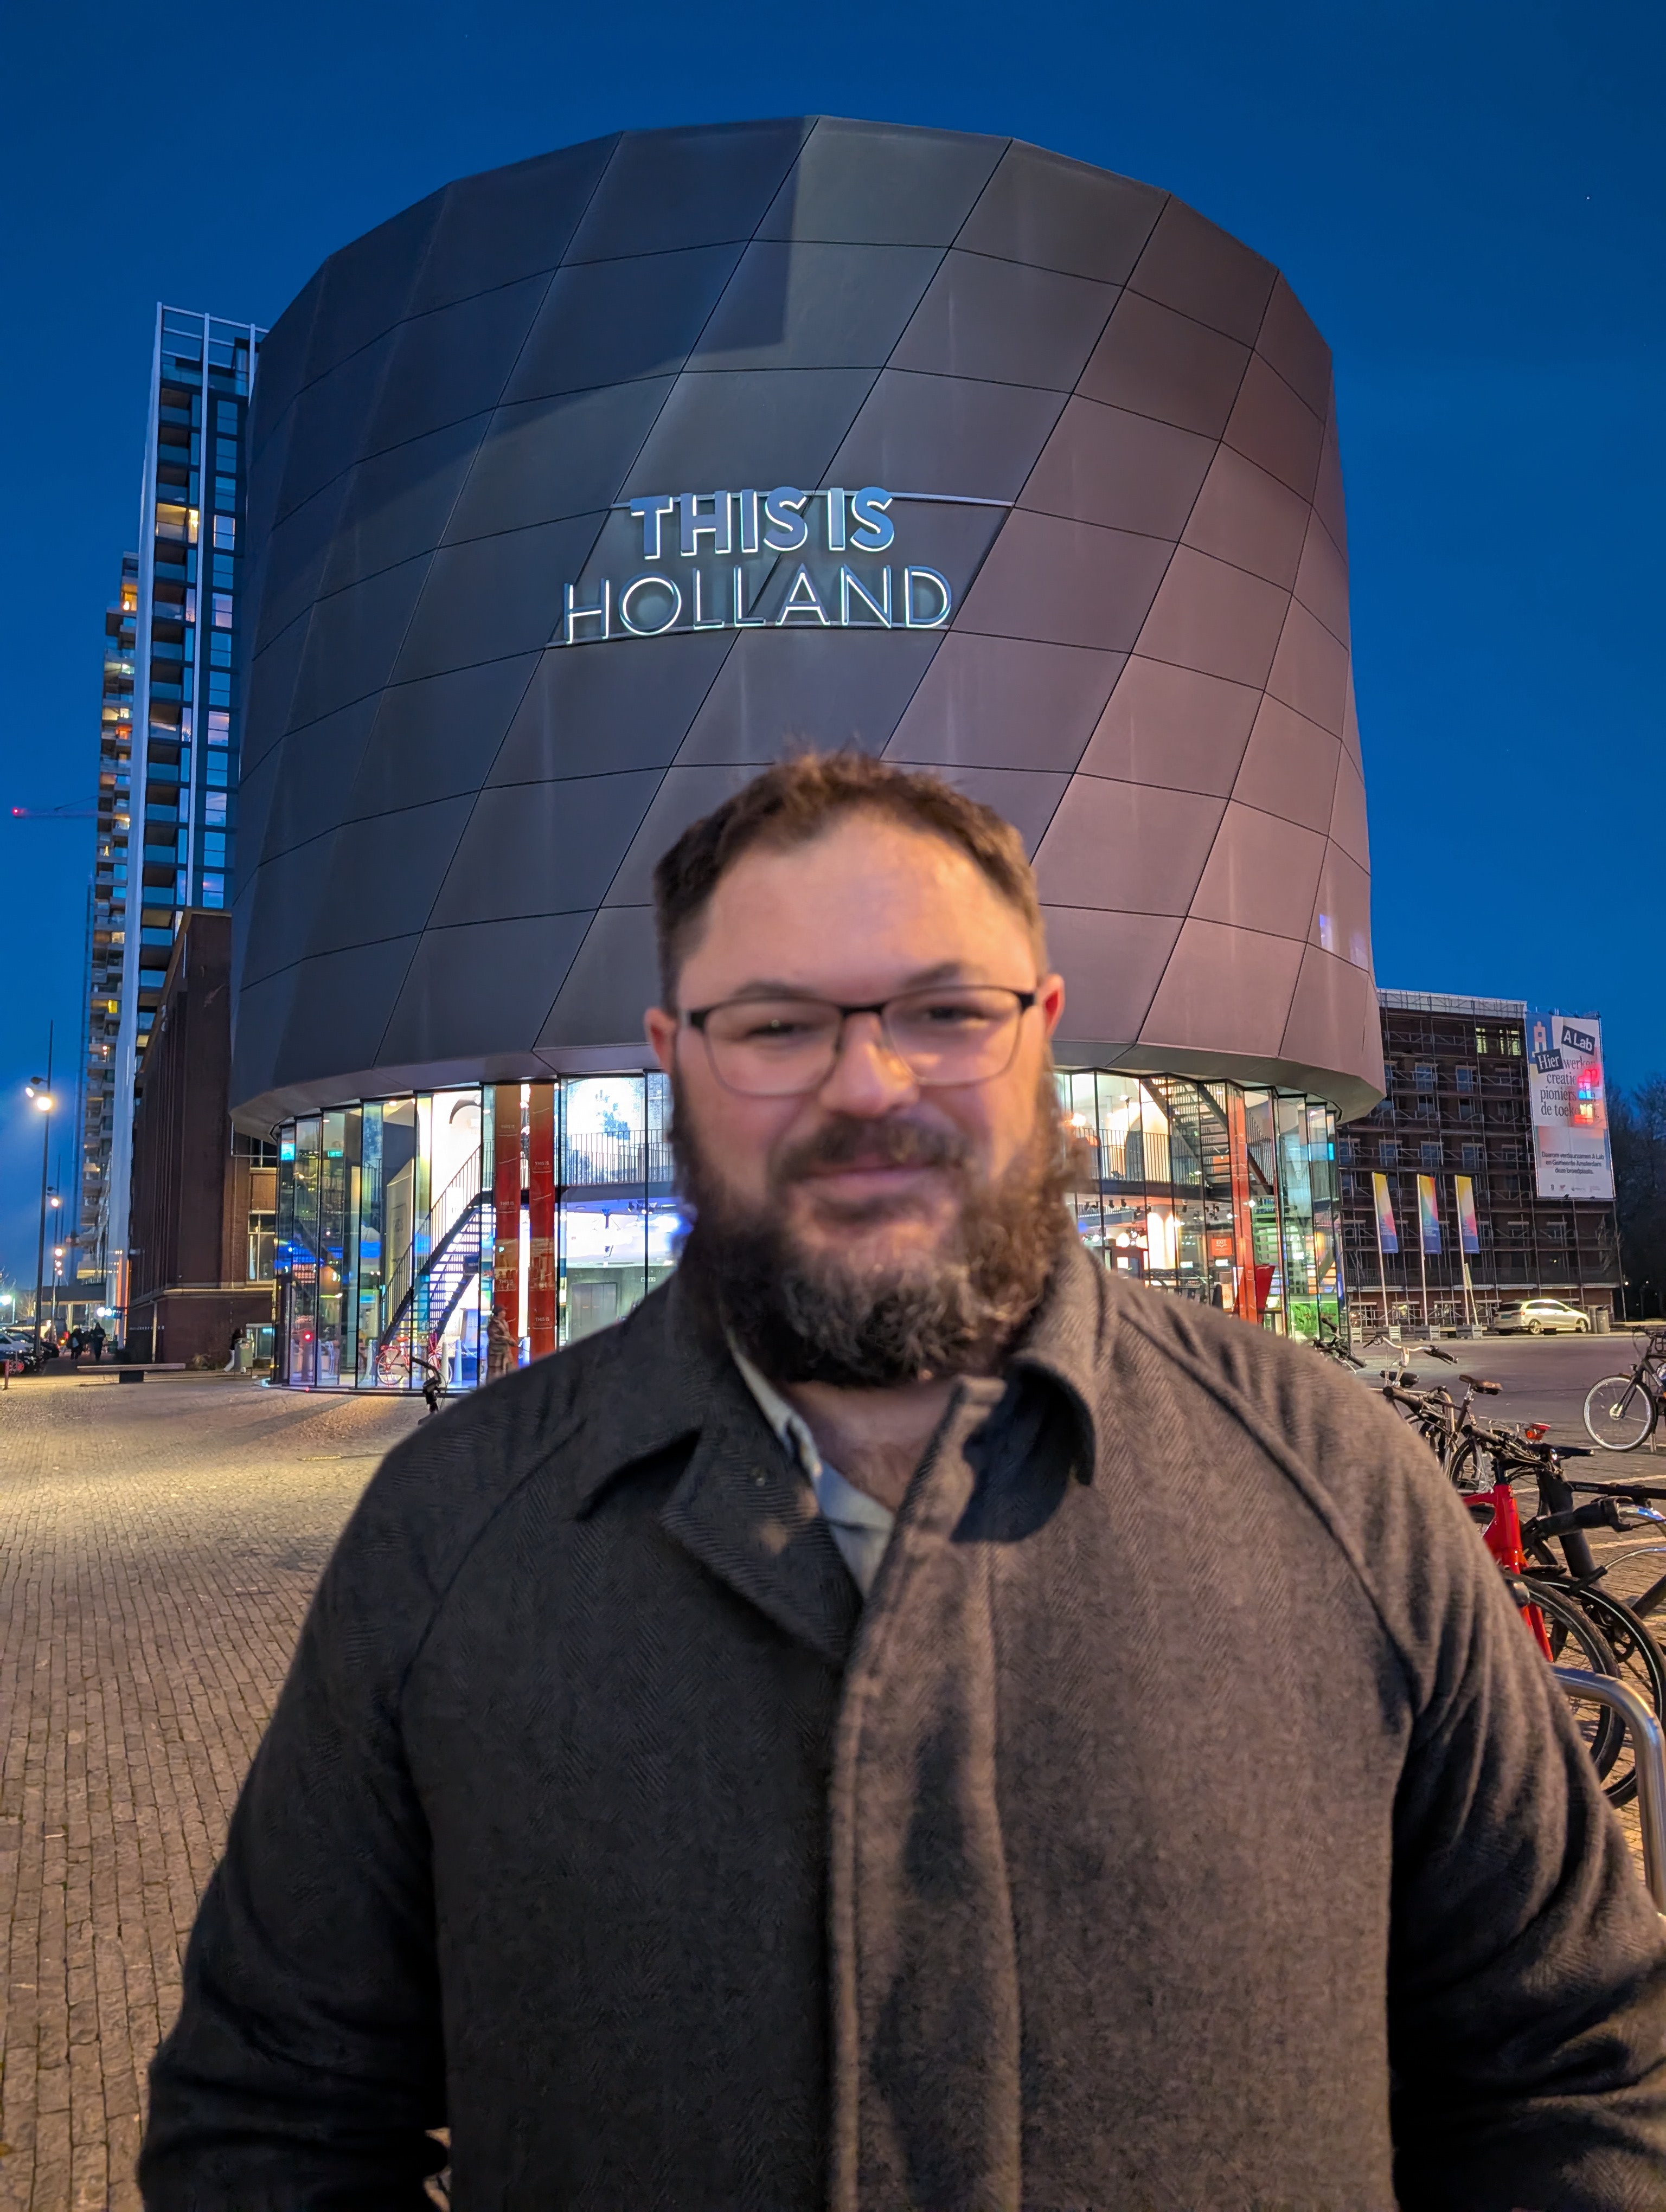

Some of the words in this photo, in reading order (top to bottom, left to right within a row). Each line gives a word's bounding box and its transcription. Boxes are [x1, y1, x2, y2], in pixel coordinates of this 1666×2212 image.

[630, 486, 808, 560] THIS
[828, 486, 895, 552] IS
[563, 563, 952, 645] HOLLAND
[1564, 1030, 1572, 1044] A
[1573, 1033, 1593, 1051] Lab
[1537, 1054, 1560, 1070] Hier
[1540, 1086, 1577, 1102] pioniers
[1541, 1102, 1552, 1116] de
